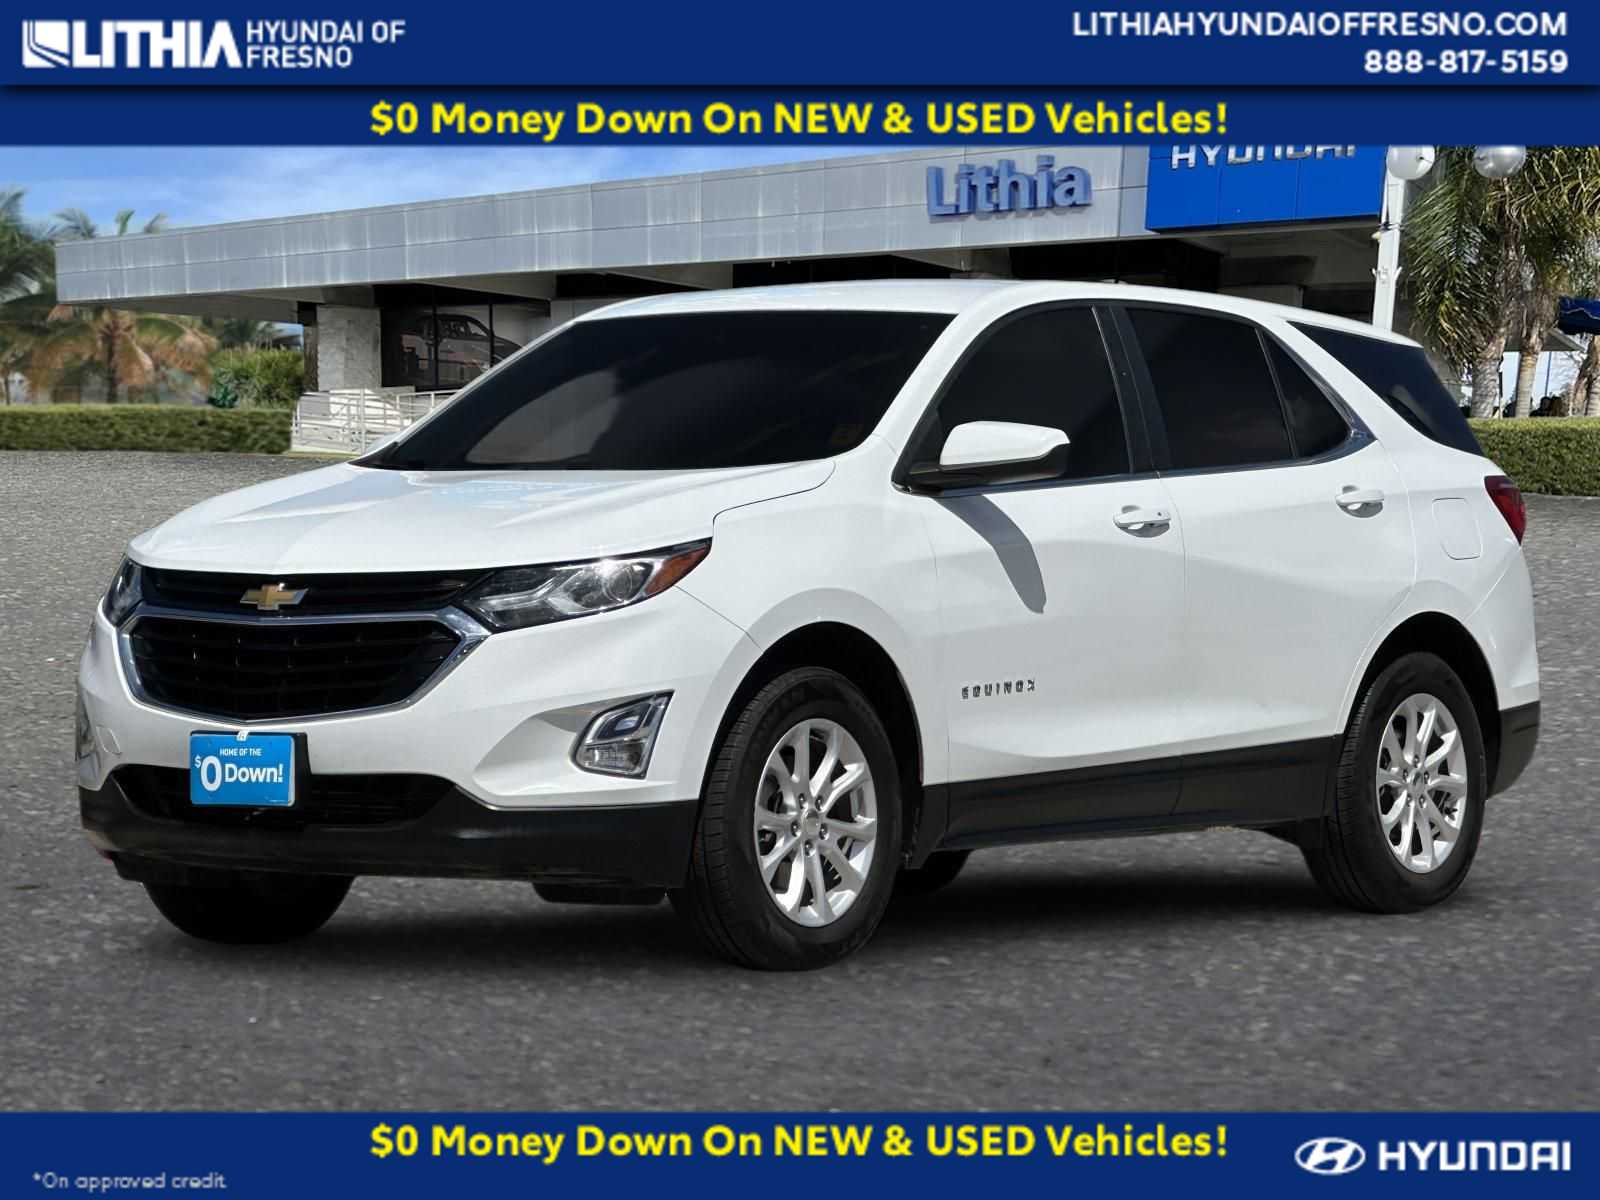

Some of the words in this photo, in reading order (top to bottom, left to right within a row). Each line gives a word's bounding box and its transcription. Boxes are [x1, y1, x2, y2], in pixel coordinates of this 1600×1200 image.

[926, 154, 1092, 216] Lithia
[961, 679, 1036, 700] EQUINOX
[219, 748, 238, 757] HOME
[239, 748, 248, 757] OF
[249, 748, 262, 757] THE
[224, 763, 284, 783] Down!
